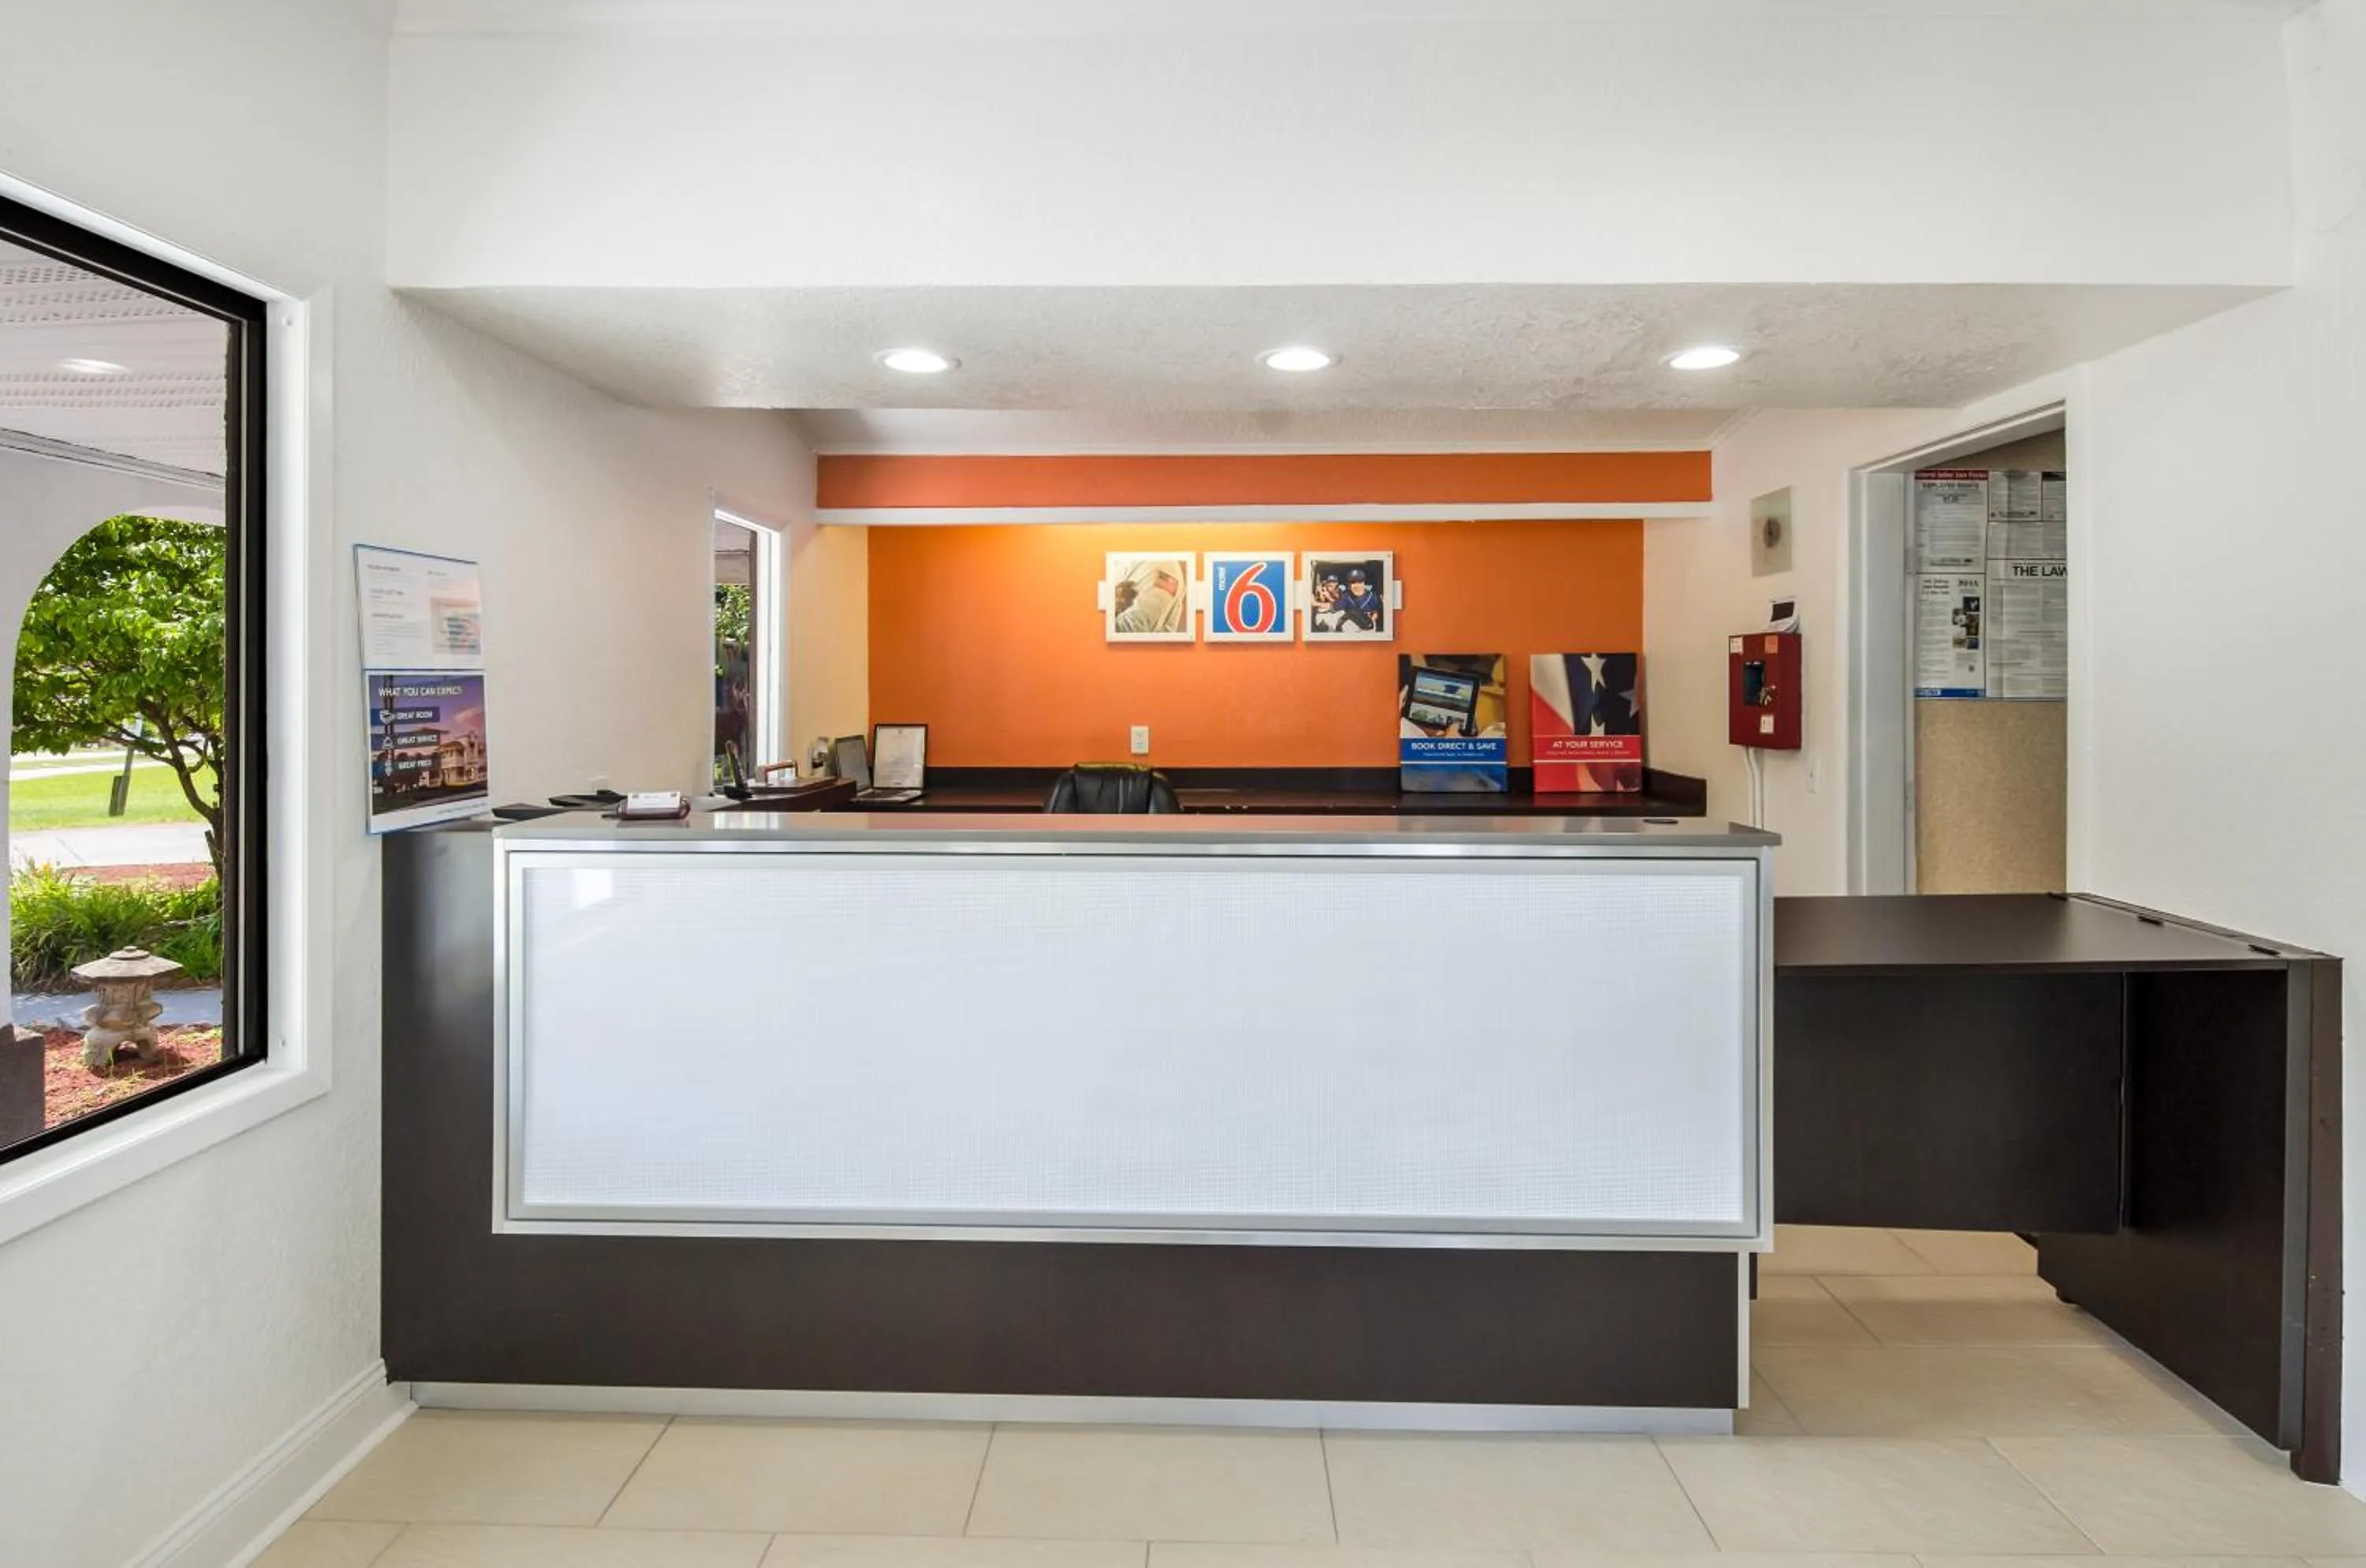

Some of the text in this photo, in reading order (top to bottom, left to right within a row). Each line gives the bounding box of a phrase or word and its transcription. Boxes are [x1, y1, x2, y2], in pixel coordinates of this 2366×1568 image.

[2013, 566, 2039, 577] THE
[1224, 562, 1277, 634] 6
[379, 687, 401, 696] WHAT
[403, 687, 419, 696] YOU
[420, 687, 436, 696] CAN
